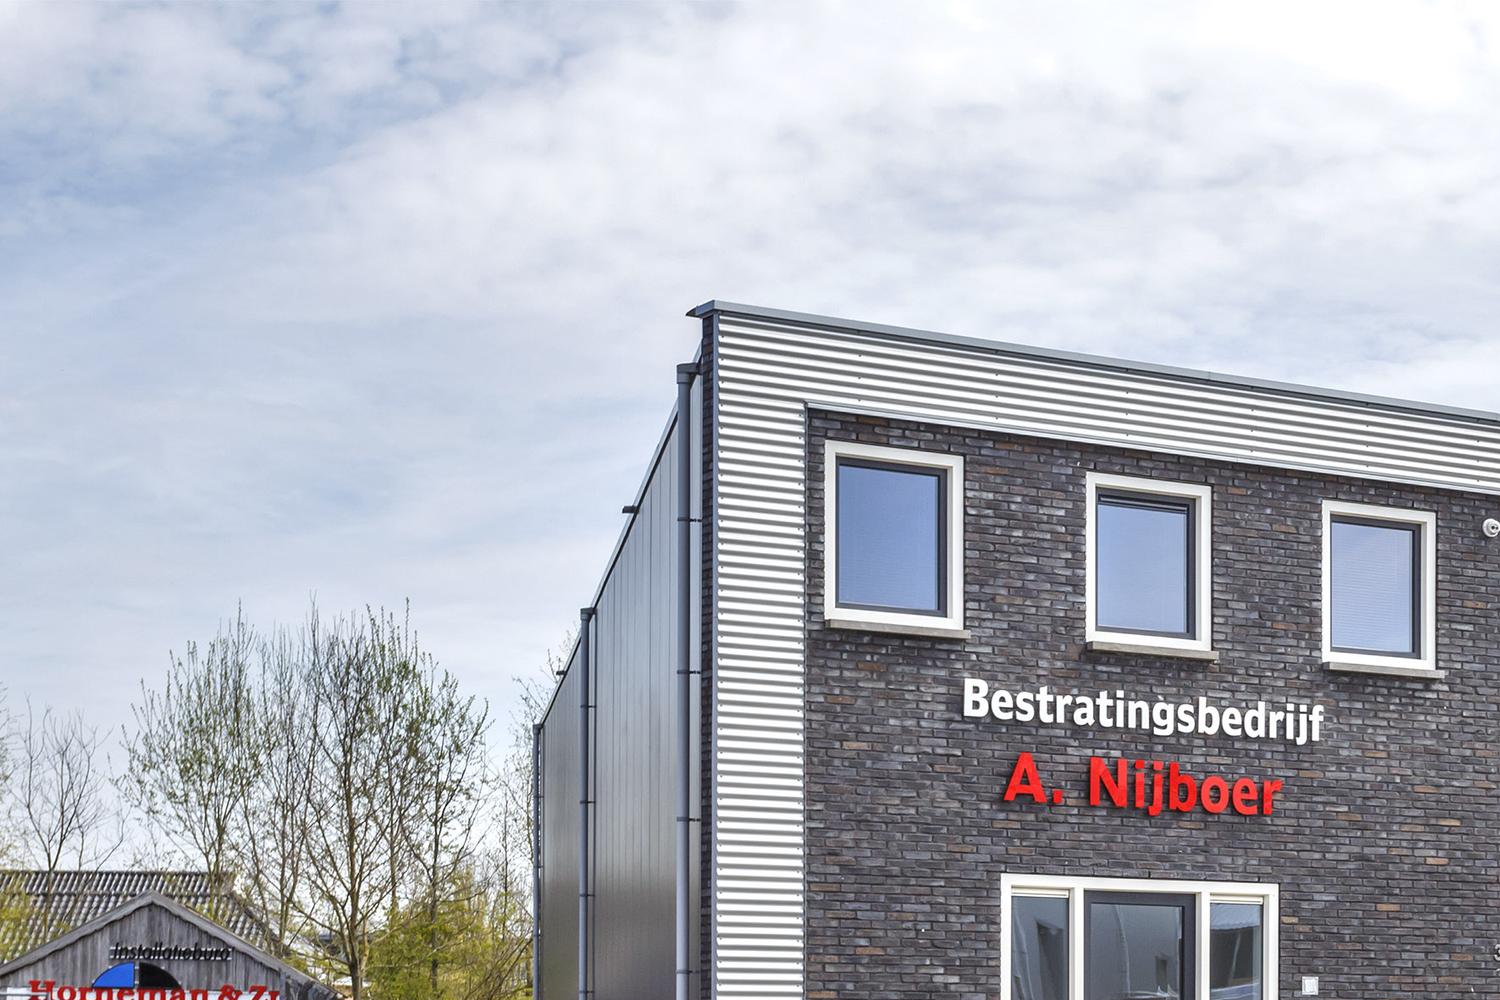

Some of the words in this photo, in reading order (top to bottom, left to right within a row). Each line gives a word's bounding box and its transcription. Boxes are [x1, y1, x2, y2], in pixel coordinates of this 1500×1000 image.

[963, 678, 1324, 745] Bestratingsbedrijf
[1003, 752, 1064, 804] A.
[1089, 756, 1284, 816] Nijboer
